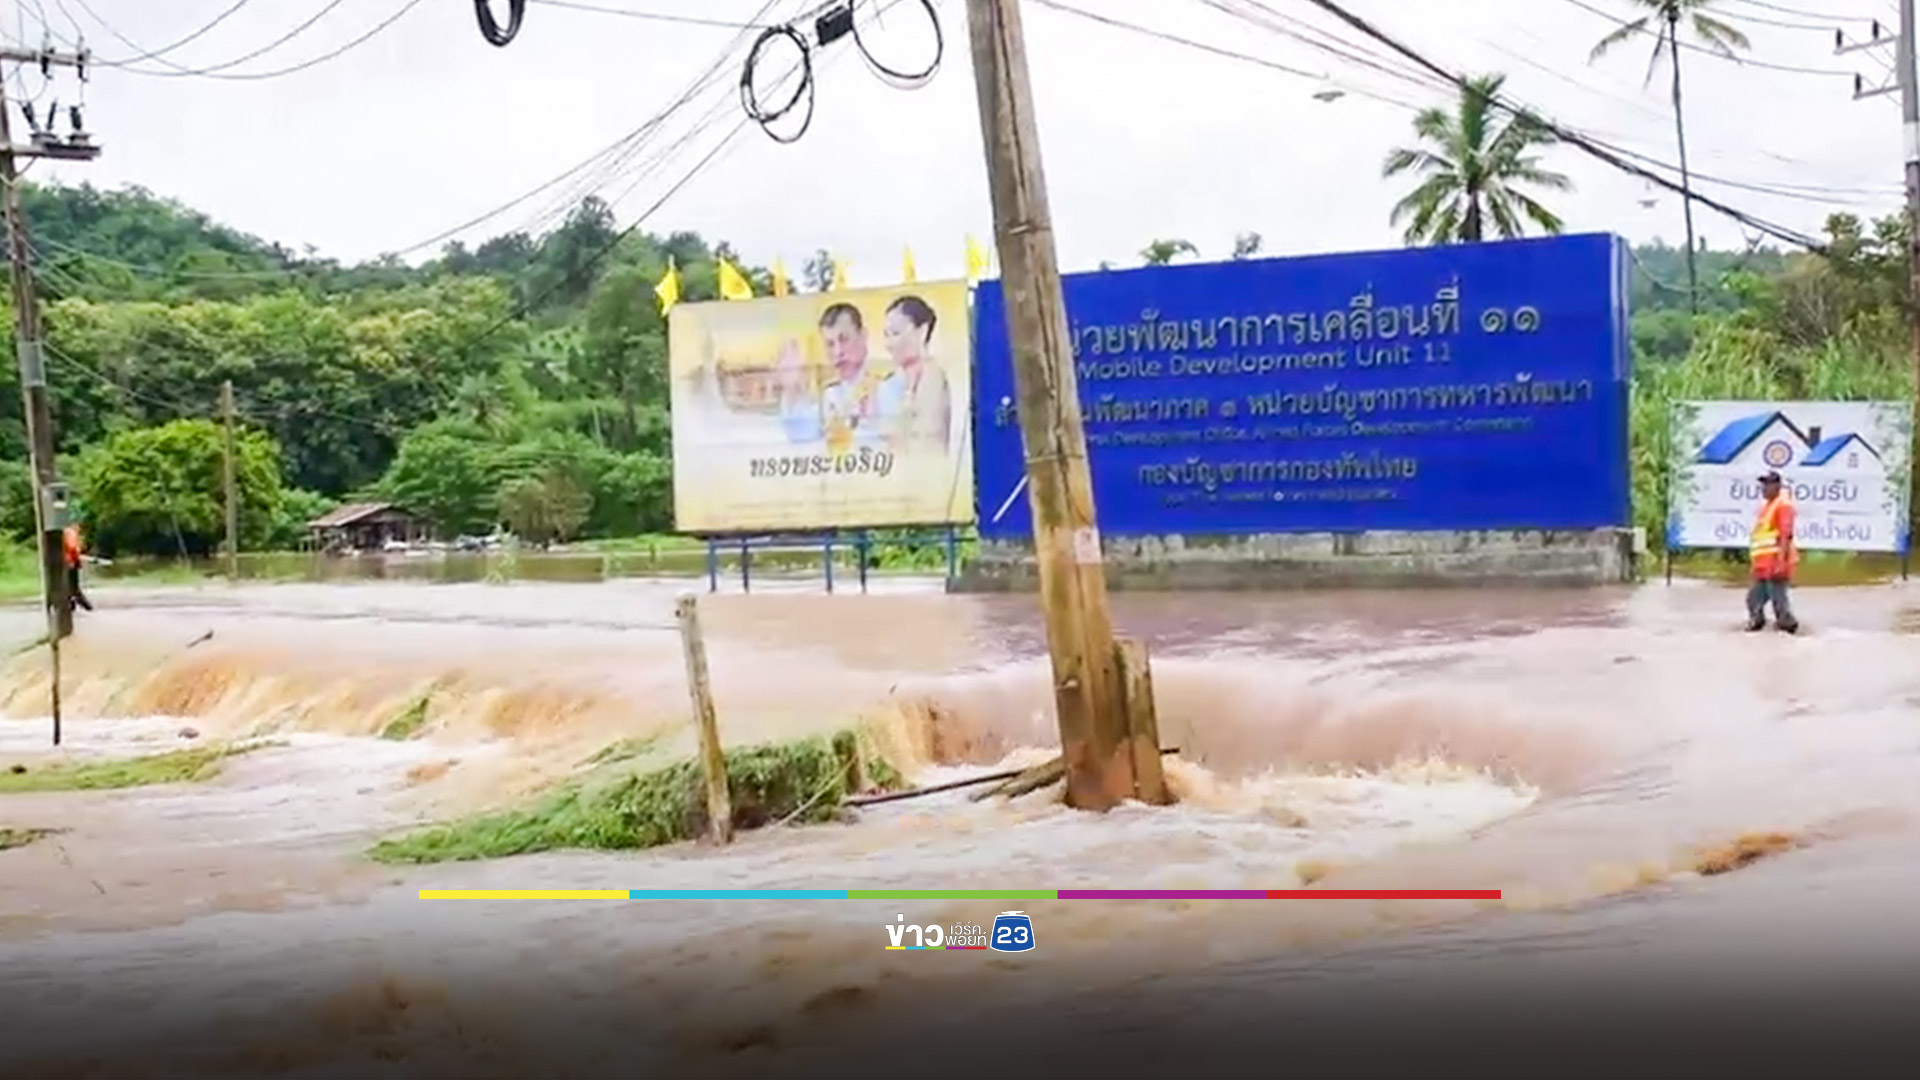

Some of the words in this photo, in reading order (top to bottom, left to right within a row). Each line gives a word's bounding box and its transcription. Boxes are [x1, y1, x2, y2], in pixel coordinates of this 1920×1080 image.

[1072, 273, 1461, 355] ่วยพัฒนาการเคลื่อนที่
[1480, 306, 1541, 333] ๑๑
[1079, 358, 1161, 380] Mobile
[1169, 346, 1347, 377] Development
[1356, 343, 1412, 367] Unit
[1423, 341, 1452, 363] 11
[750, 446, 893, 478] ทรงพระเจริญ
